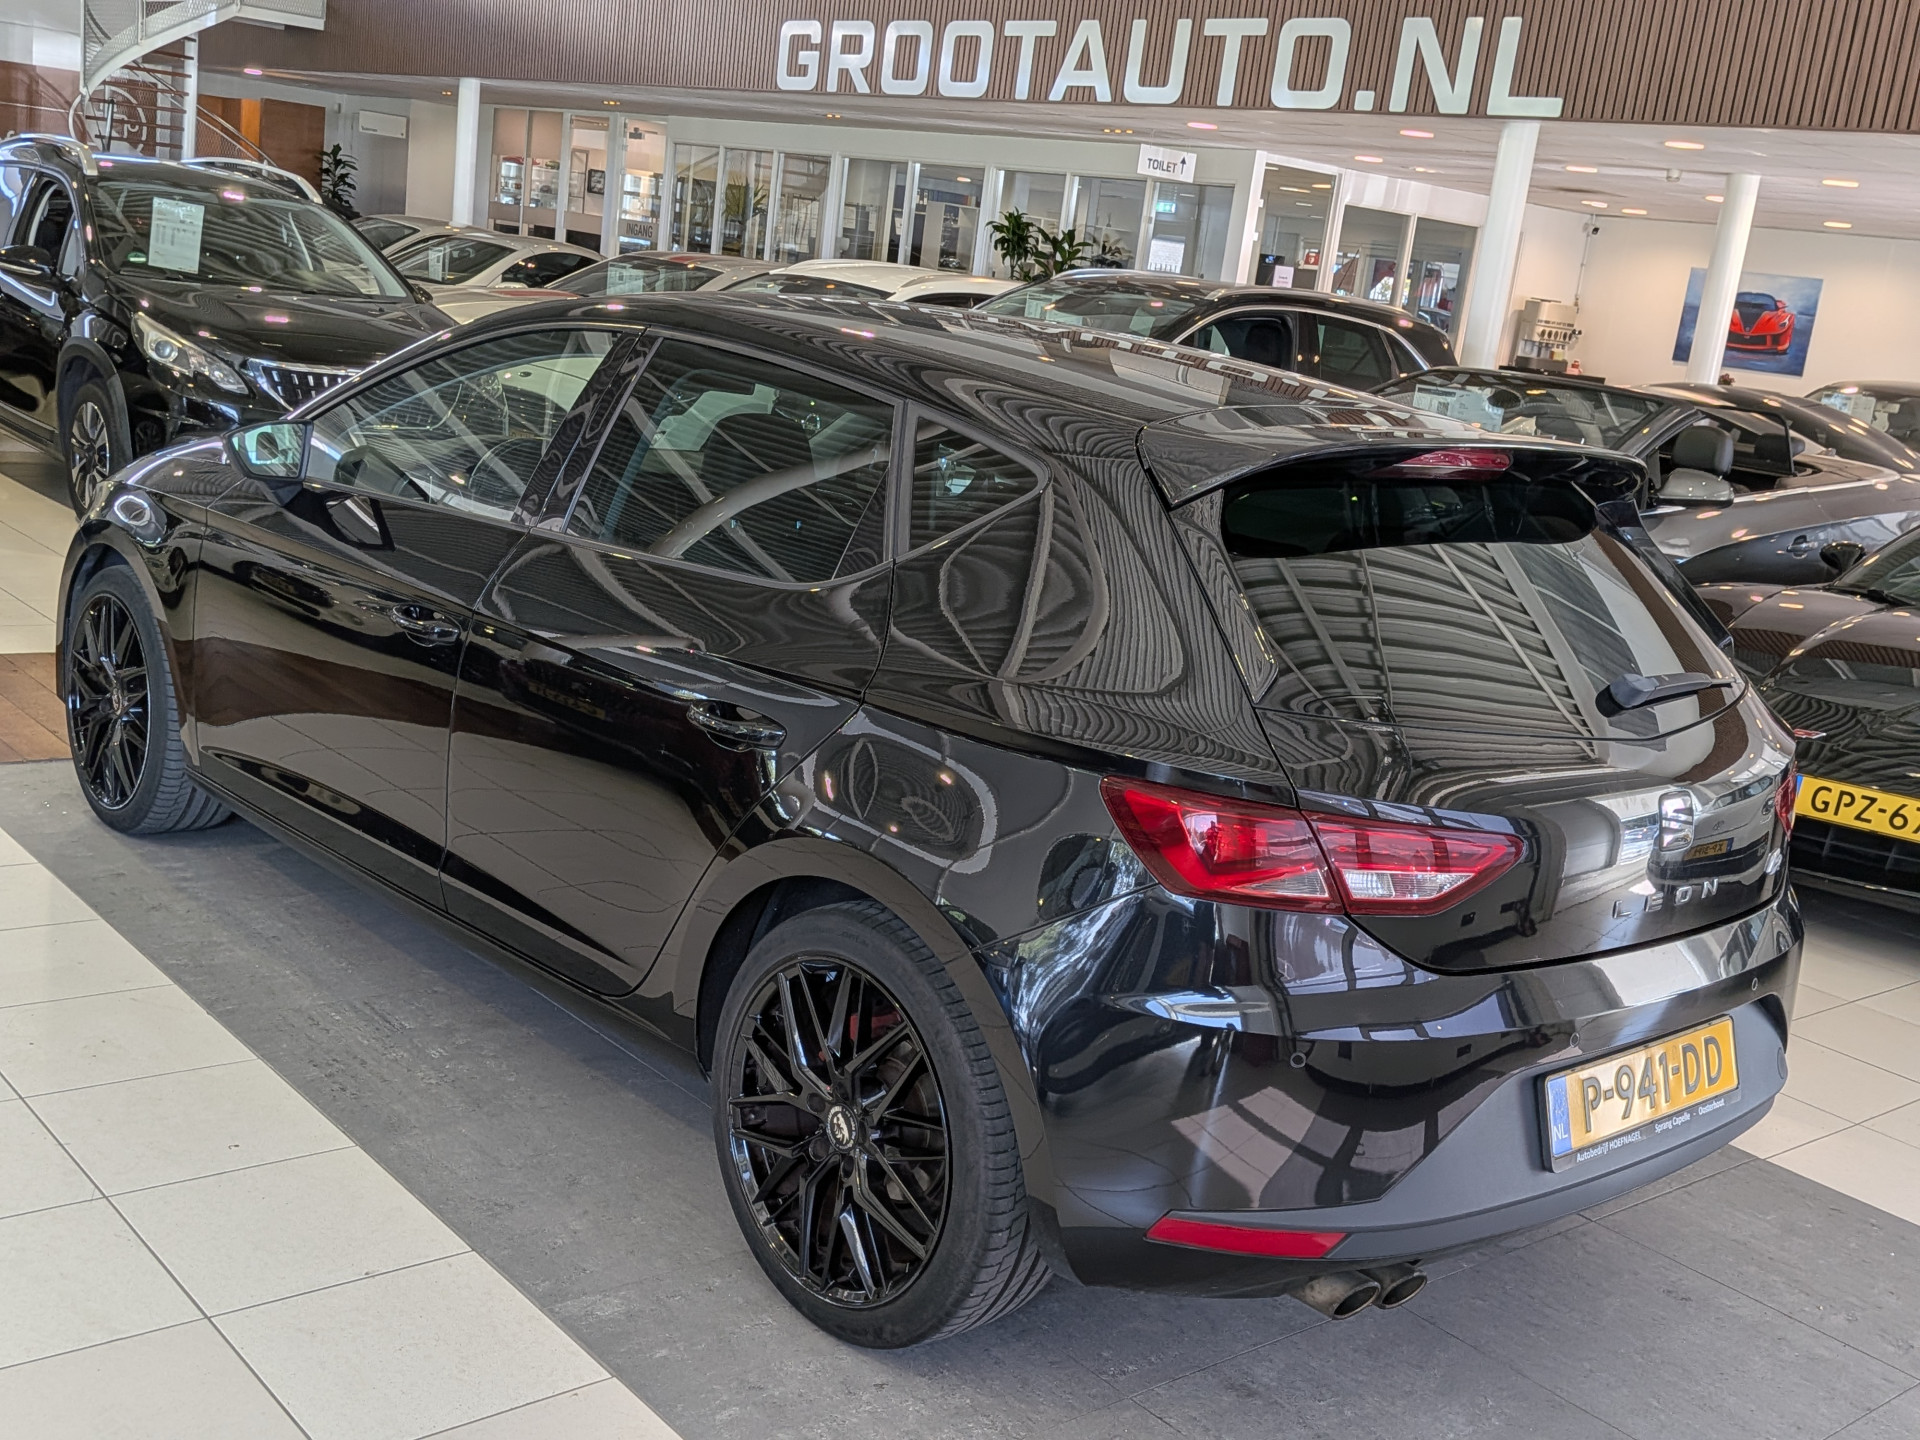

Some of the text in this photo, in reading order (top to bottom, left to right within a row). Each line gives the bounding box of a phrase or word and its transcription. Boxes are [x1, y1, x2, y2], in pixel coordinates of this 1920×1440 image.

[777, 16, 1563, 118] GROOTAUTO.NL
[1147, 157, 1178, 174] TOILET
[626, 222, 653, 238] INGANG
[1612, 878, 1719, 919] LEON
[1582, 1035, 1723, 1134] P-941-DD
[1553, 1123, 1569, 1142] NL
[1654, 1120, 1672, 1134] Sprang
[1672, 1112, 1691, 1128] Capelle
[1698, 1099, 1725, 1116] Oosterhout
[1576, 1130, 1642, 1163] Autobedrijf HOEFNAGEL
